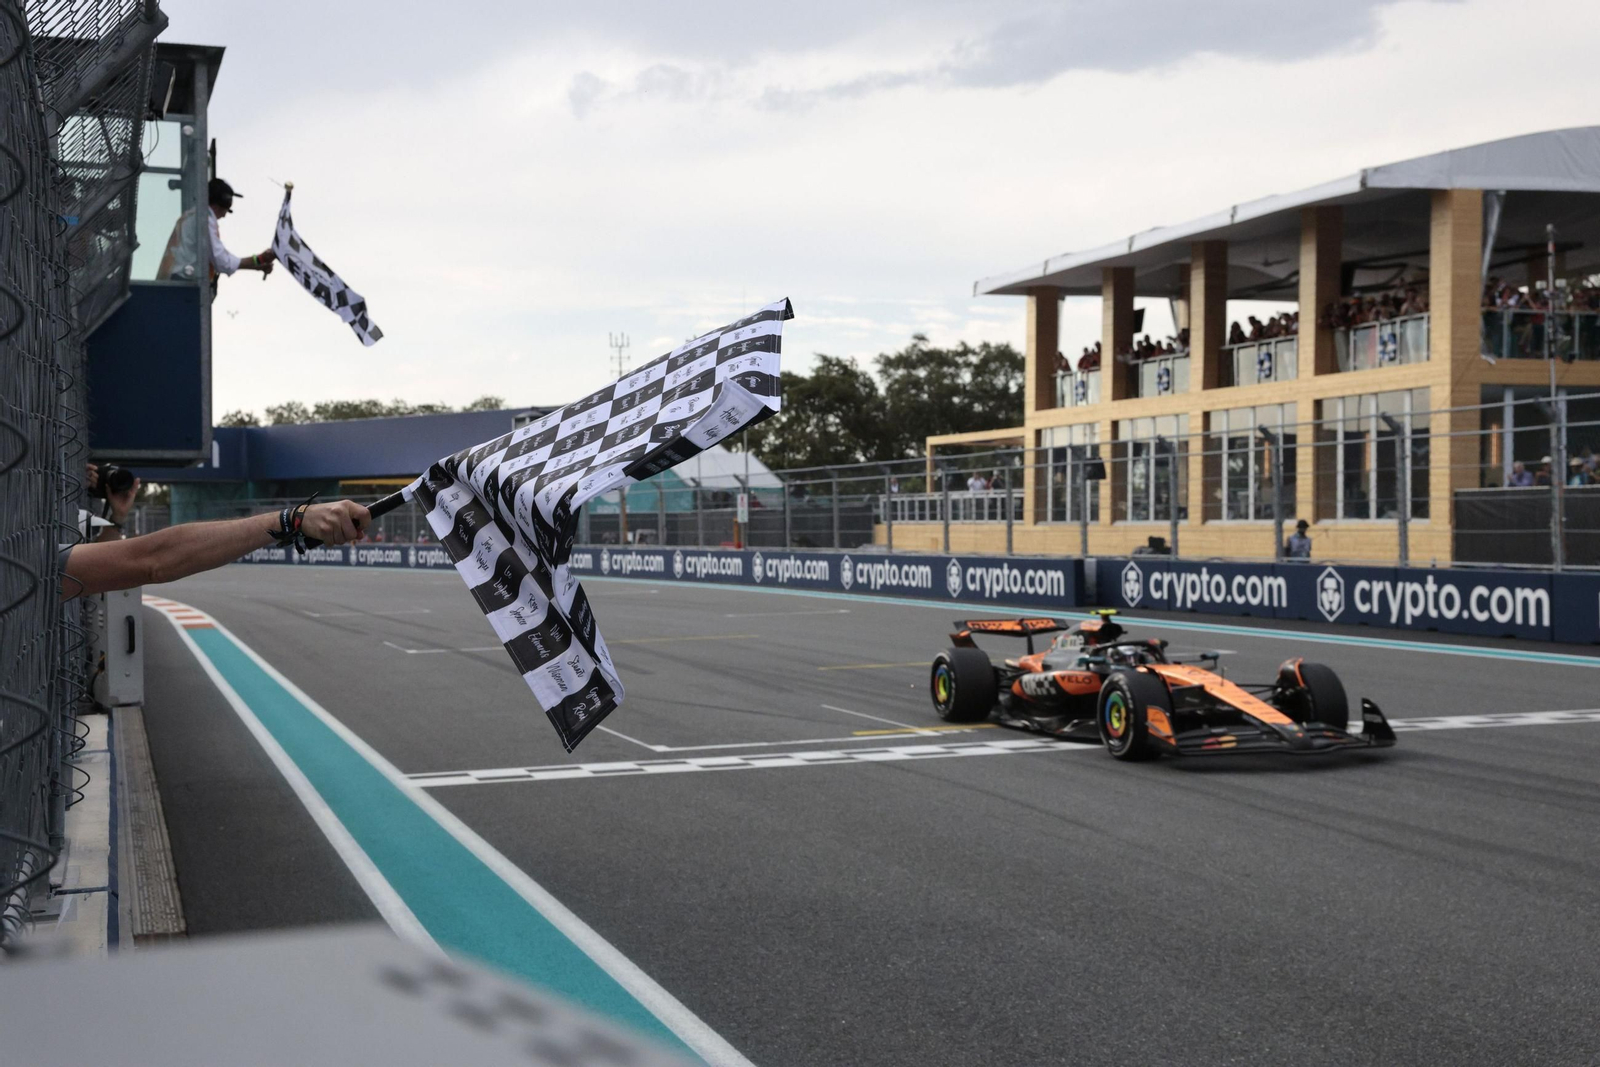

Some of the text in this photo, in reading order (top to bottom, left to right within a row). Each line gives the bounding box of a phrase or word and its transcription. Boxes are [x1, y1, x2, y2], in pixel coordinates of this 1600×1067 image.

[358, 547, 402, 566] crypto.com
[611, 550, 664, 574] crypto.com
[685, 553, 743, 578] crypto.com
[765, 555, 830, 583] crypto.com
[856, 559, 932, 590] crypto.com
[965, 562, 1065, 599] crypto.com
[1149, 566, 1288, 609] crypto.com
[1353, 574, 1550, 626] crypto.com
[527, 632, 550, 660] Edwards
[546, 660, 567, 694] Wiseman
[567, 655, 585, 678] Stuart
[1059, 674, 1093, 685] VELO
